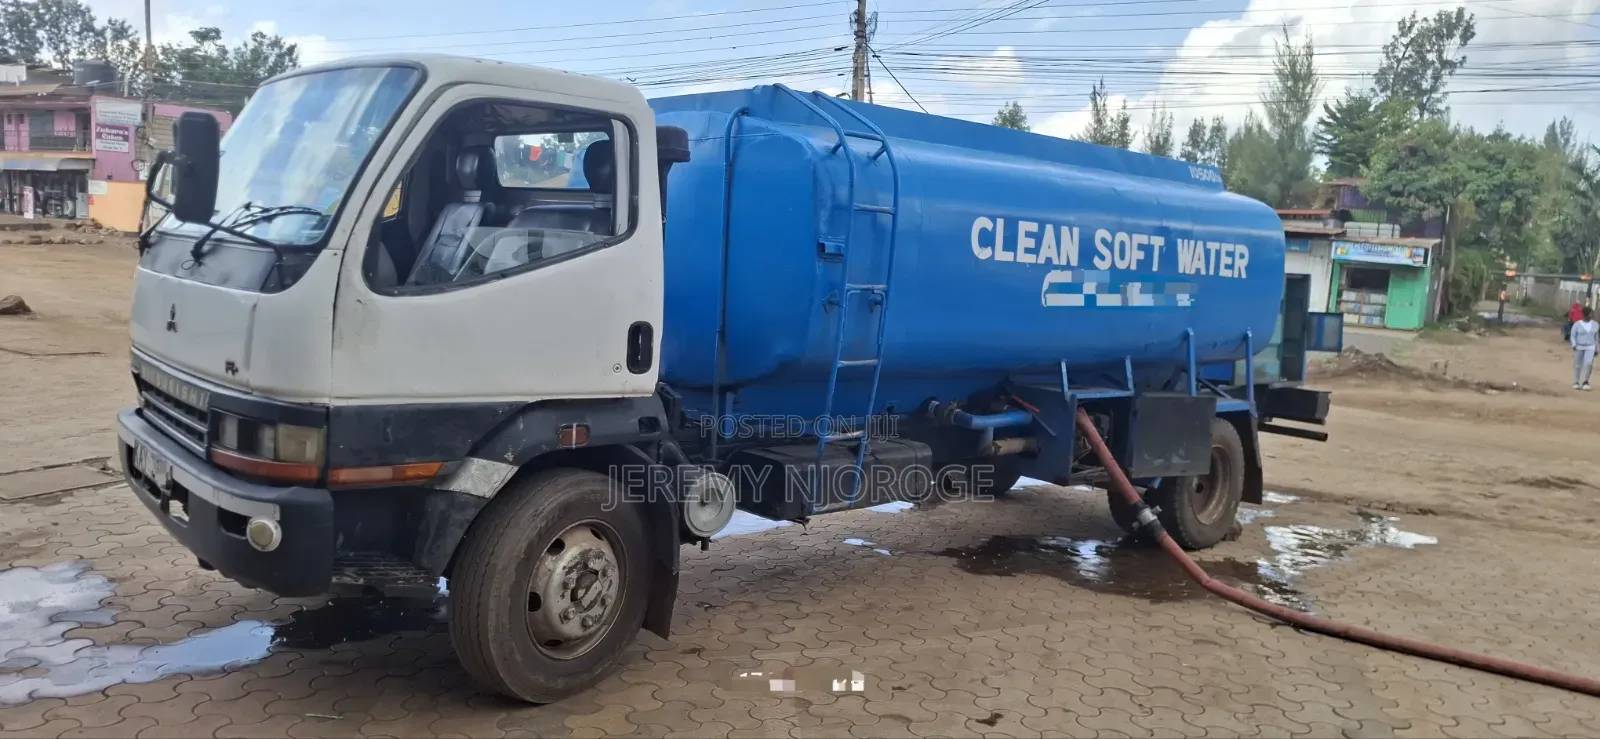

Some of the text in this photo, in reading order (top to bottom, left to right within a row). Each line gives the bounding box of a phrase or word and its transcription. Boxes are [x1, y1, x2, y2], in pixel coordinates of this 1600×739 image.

[971, 216, 1250, 279] CLEAN SOFT WATER
